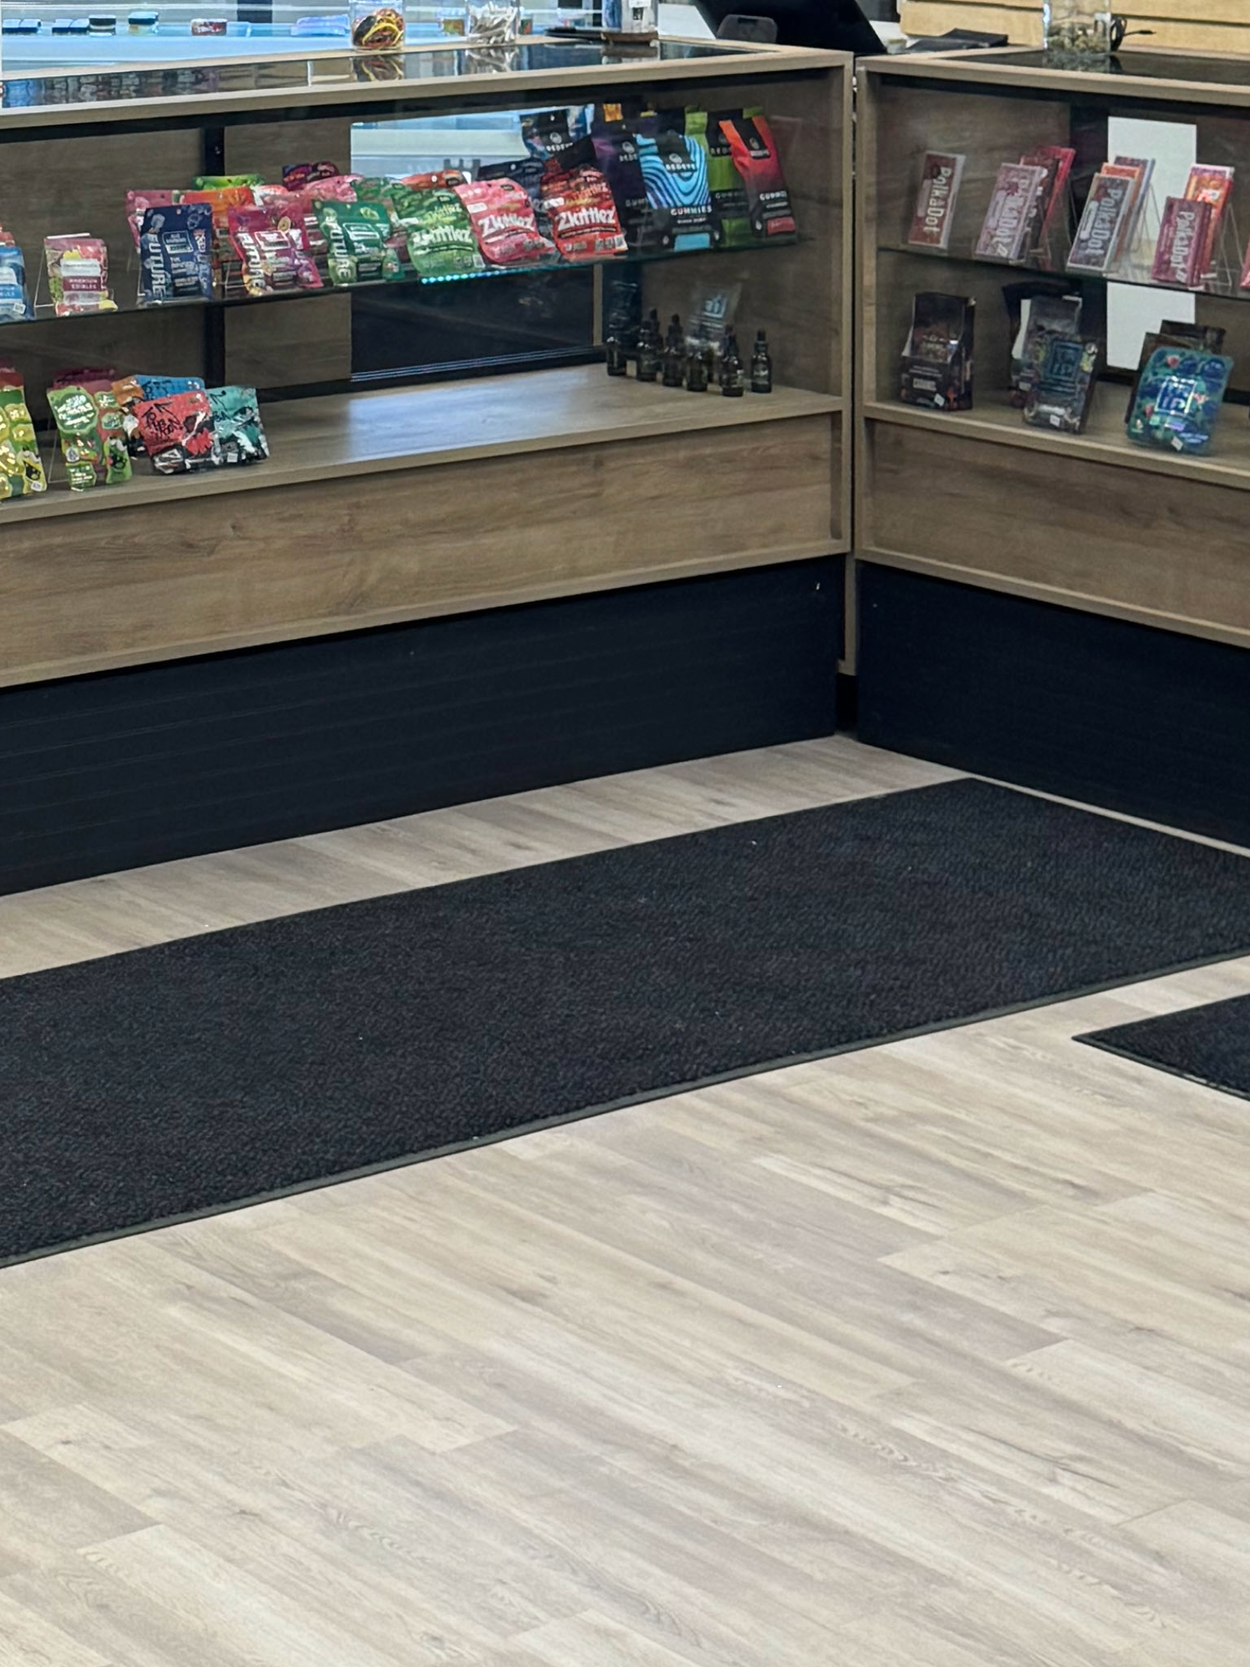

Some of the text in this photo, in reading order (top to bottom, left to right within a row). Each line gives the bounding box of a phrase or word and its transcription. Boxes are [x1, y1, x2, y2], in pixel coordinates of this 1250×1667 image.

[478, 212, 536, 238] Zkittlez
[556, 206, 617, 230] Zkittlez
[670, 205, 713, 216] GUMMIES
[923, 166, 952, 234] PolkaDot
[1085, 188, 1123, 256] PolkaDot
[329, 224, 352, 280] FUTURE
[412, 225, 473, 248] Zkittlez
[1170, 211, 1196, 271] PolkaDot
[147, 233, 167, 300] FUTURE
